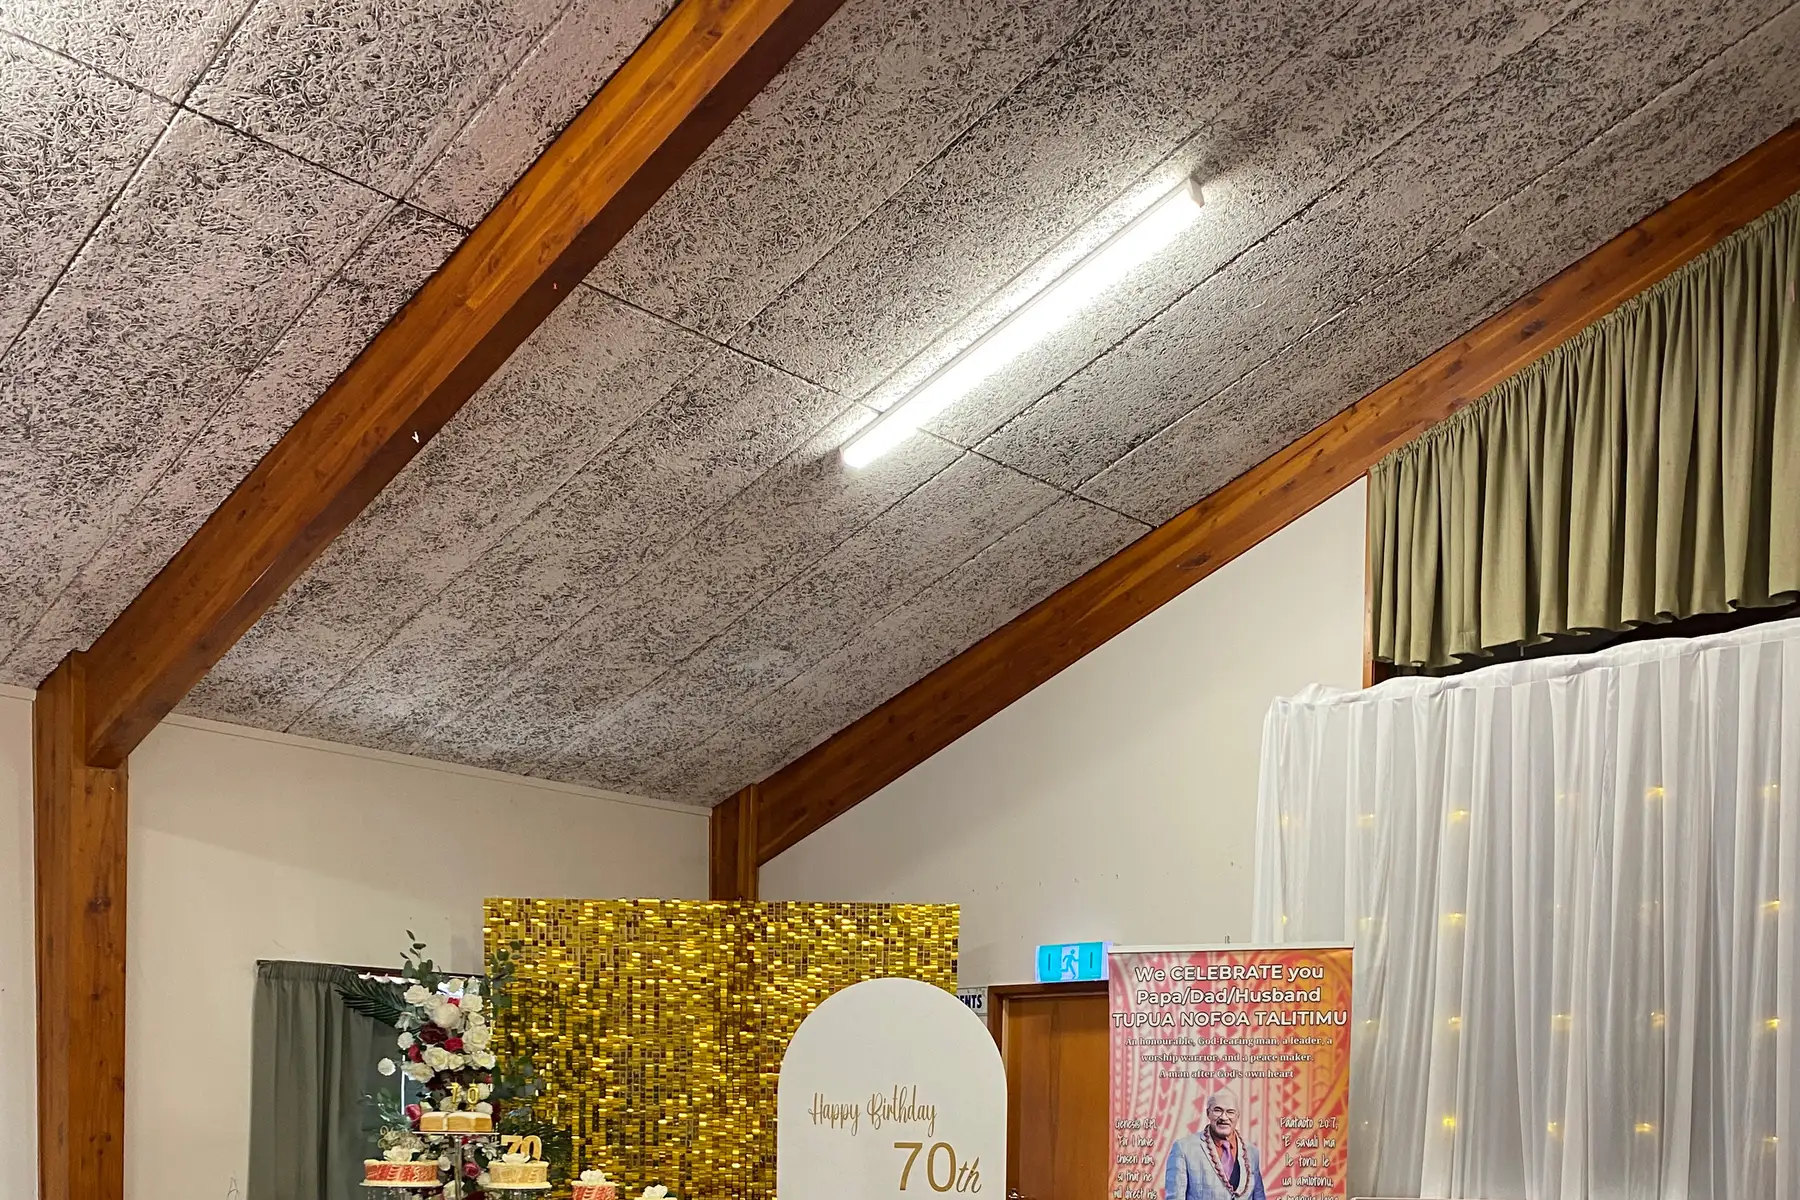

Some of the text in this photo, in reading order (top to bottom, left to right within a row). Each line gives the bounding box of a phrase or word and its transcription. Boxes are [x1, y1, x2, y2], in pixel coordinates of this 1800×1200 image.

[1135, 964, 1324, 984] We CELEBRATE you
[1136, 986, 1321, 1006] Papa/Dad/Husband
[1112, 1010, 1347, 1028] TUPUA NOFOA TALITIMU
[1126, 1038, 1138, 1046] An
[1140, 1036, 1196, 1047] honourable,
[1198, 1036, 1254, 1047] God-fearing
[1256, 1038, 1280, 1046] man,
[1290, 1036, 1324, 1046] leader,
[1141, 1053, 1178, 1064] worship
[1222, 1053, 1240, 1062] and
[1250, 1054, 1278, 1064] peace
[1280, 1052, 1314, 1062] maker.
[1159, 1070, 1168, 1078] A
[1191, 1070, 1216, 1078] after
[1217, 1070, 1242, 1078] God's
[1245, 1070, 1265, 1078] own
[1267, 1070, 1294, 1078] heart
[808, 1084, 937, 1137] Happy Birthday
[501, 1135, 542, 1160] 70
[1296, 1134, 1318, 1148] savali
[1324, 1138, 1336, 1148] ma
[894, 1142, 982, 1194] 70th
[1298, 1154, 1316, 1167] tonu
[1282, 1177, 1292, 1186] ua
